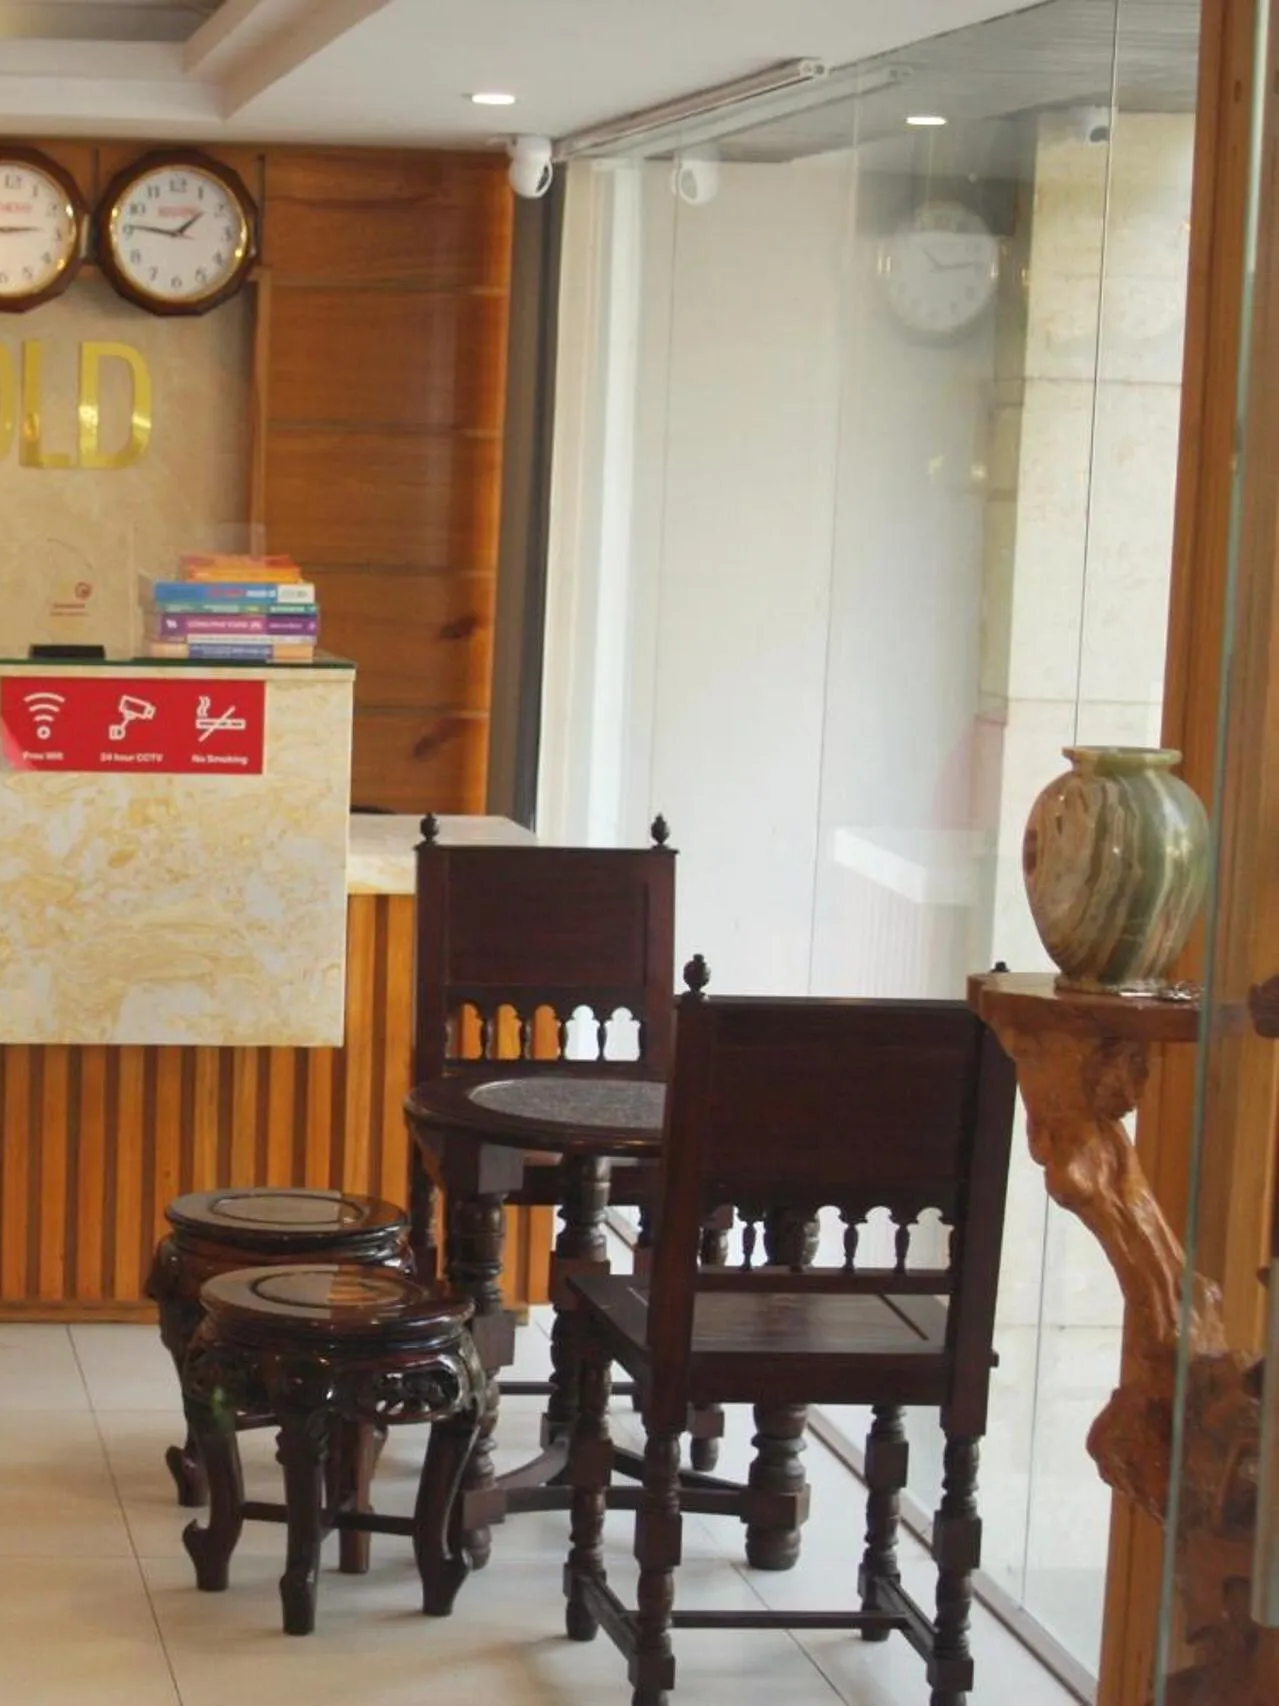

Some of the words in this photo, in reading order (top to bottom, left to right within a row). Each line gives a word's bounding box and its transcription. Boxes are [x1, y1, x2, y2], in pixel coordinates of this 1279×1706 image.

[22, 751, 44, 761] Free
[100, 752, 112, 763] 24
[113, 752, 135, 763] hour
[136, 753, 163, 763] CCTV
[191, 754, 205, 763] No
[206, 754, 249, 766] Smoking
